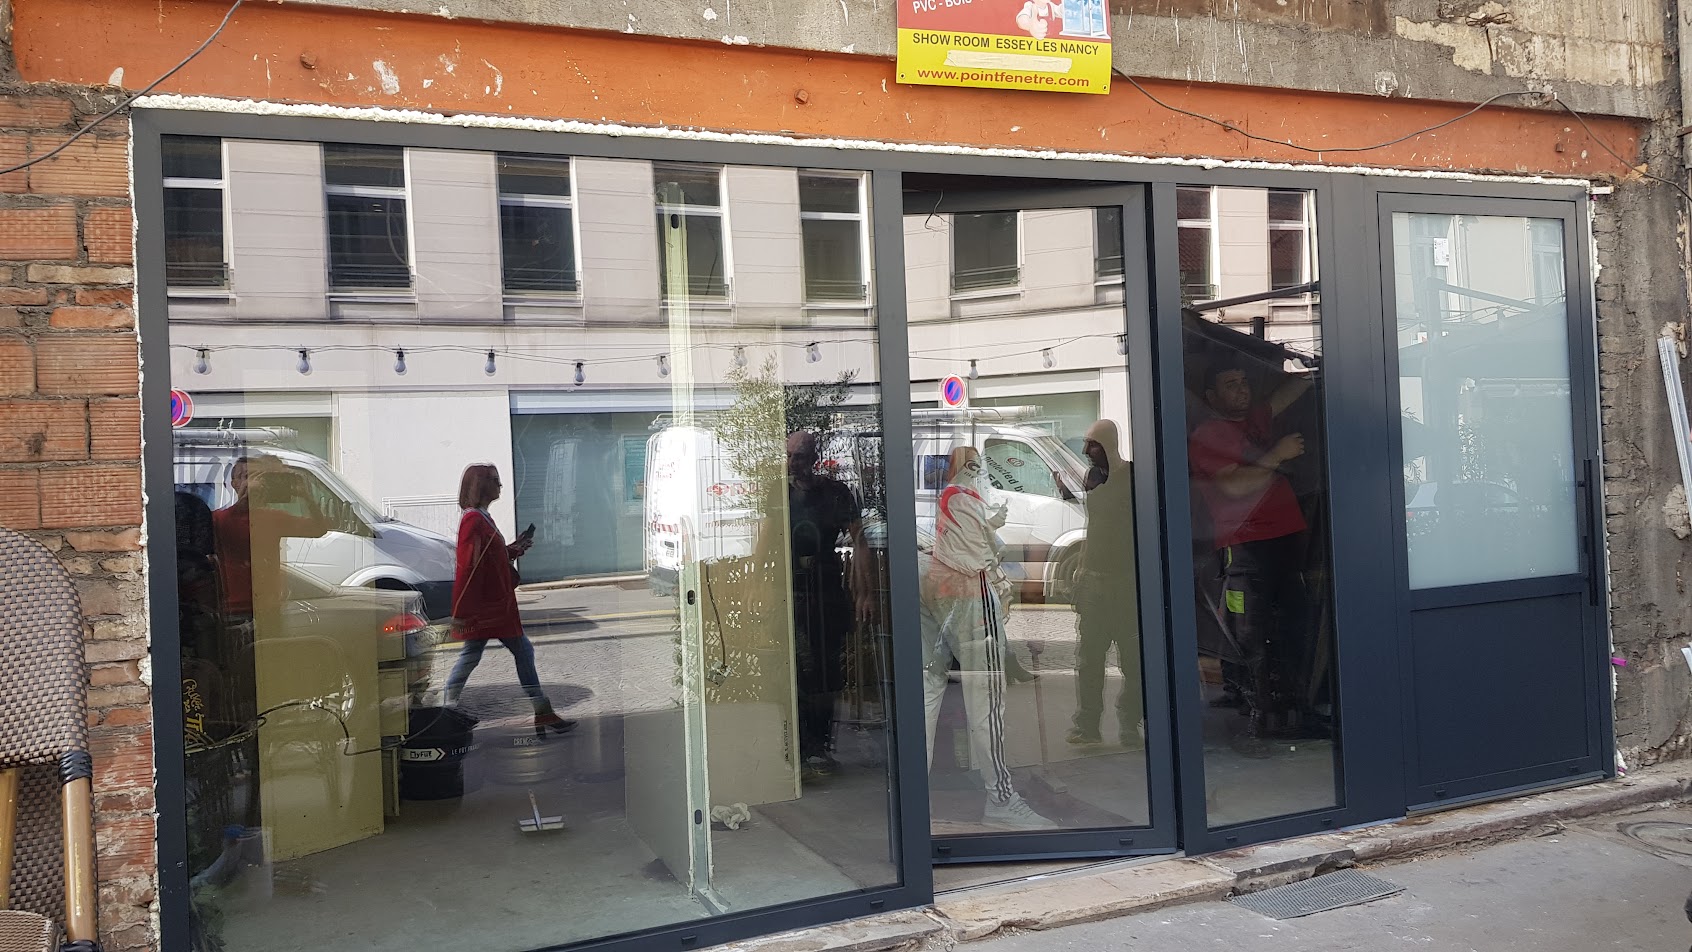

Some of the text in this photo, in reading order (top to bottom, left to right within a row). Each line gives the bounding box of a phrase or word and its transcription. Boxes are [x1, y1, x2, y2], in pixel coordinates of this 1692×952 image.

[913, 0, 937, 14] PVC
[913, 32, 1099, 56] SHOW ROOM ESSEY LES NANCY
[917, 69, 1090, 87] www.pointfenetre.com
